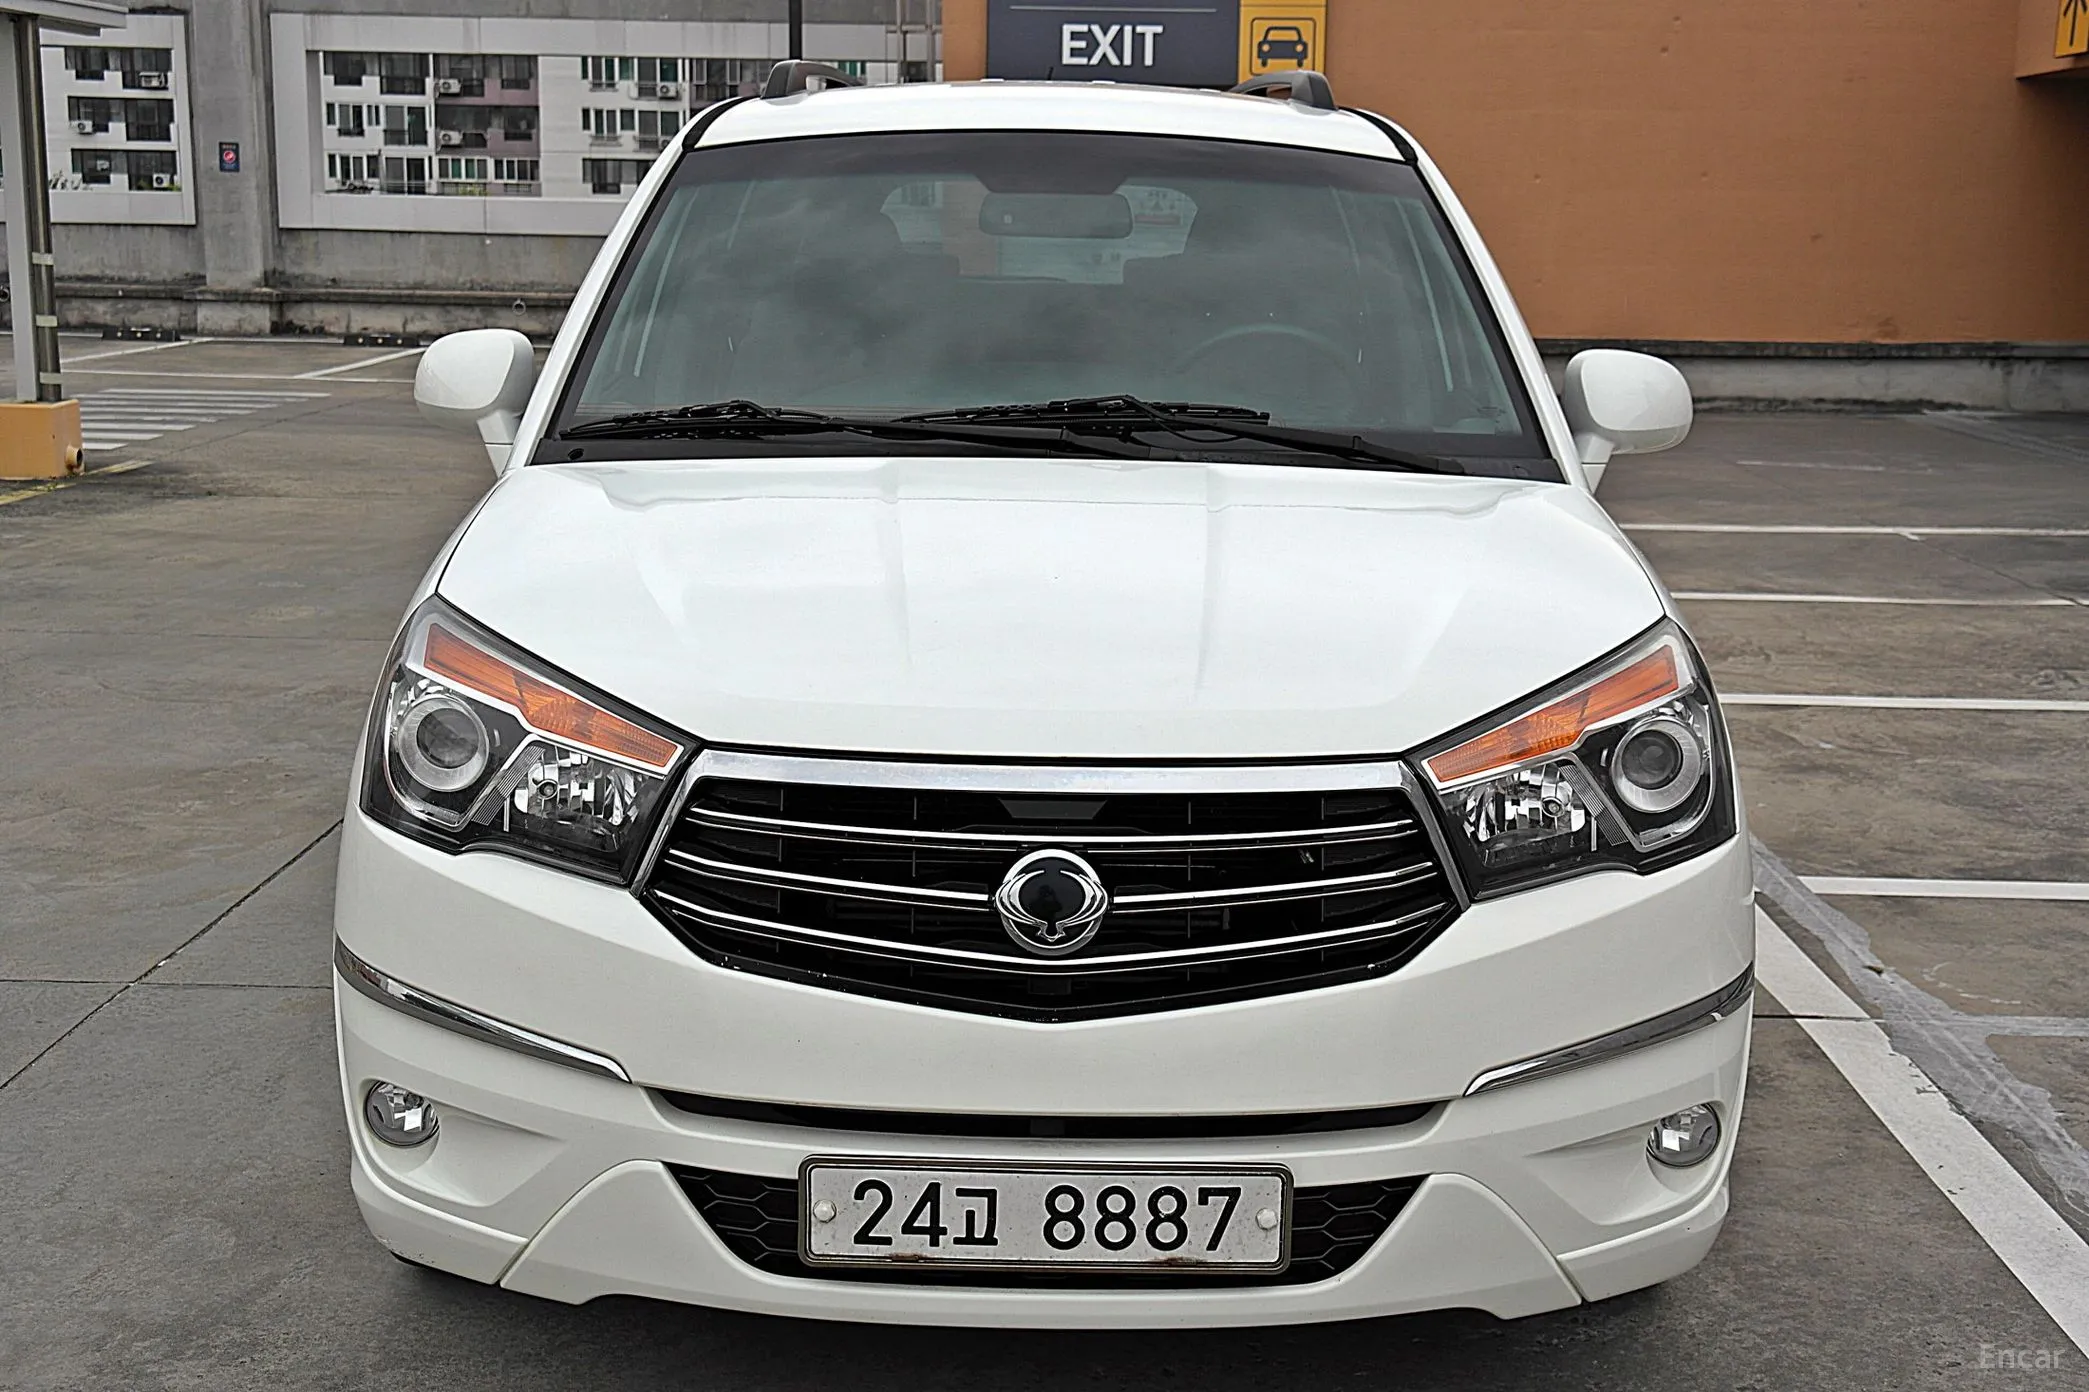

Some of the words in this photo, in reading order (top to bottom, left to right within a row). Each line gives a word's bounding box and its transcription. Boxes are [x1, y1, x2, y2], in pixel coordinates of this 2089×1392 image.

[1062, 24, 1164, 67] EXIT
[853, 1179, 999, 1248] 24고
[1043, 1184, 1242, 1252] 8887
